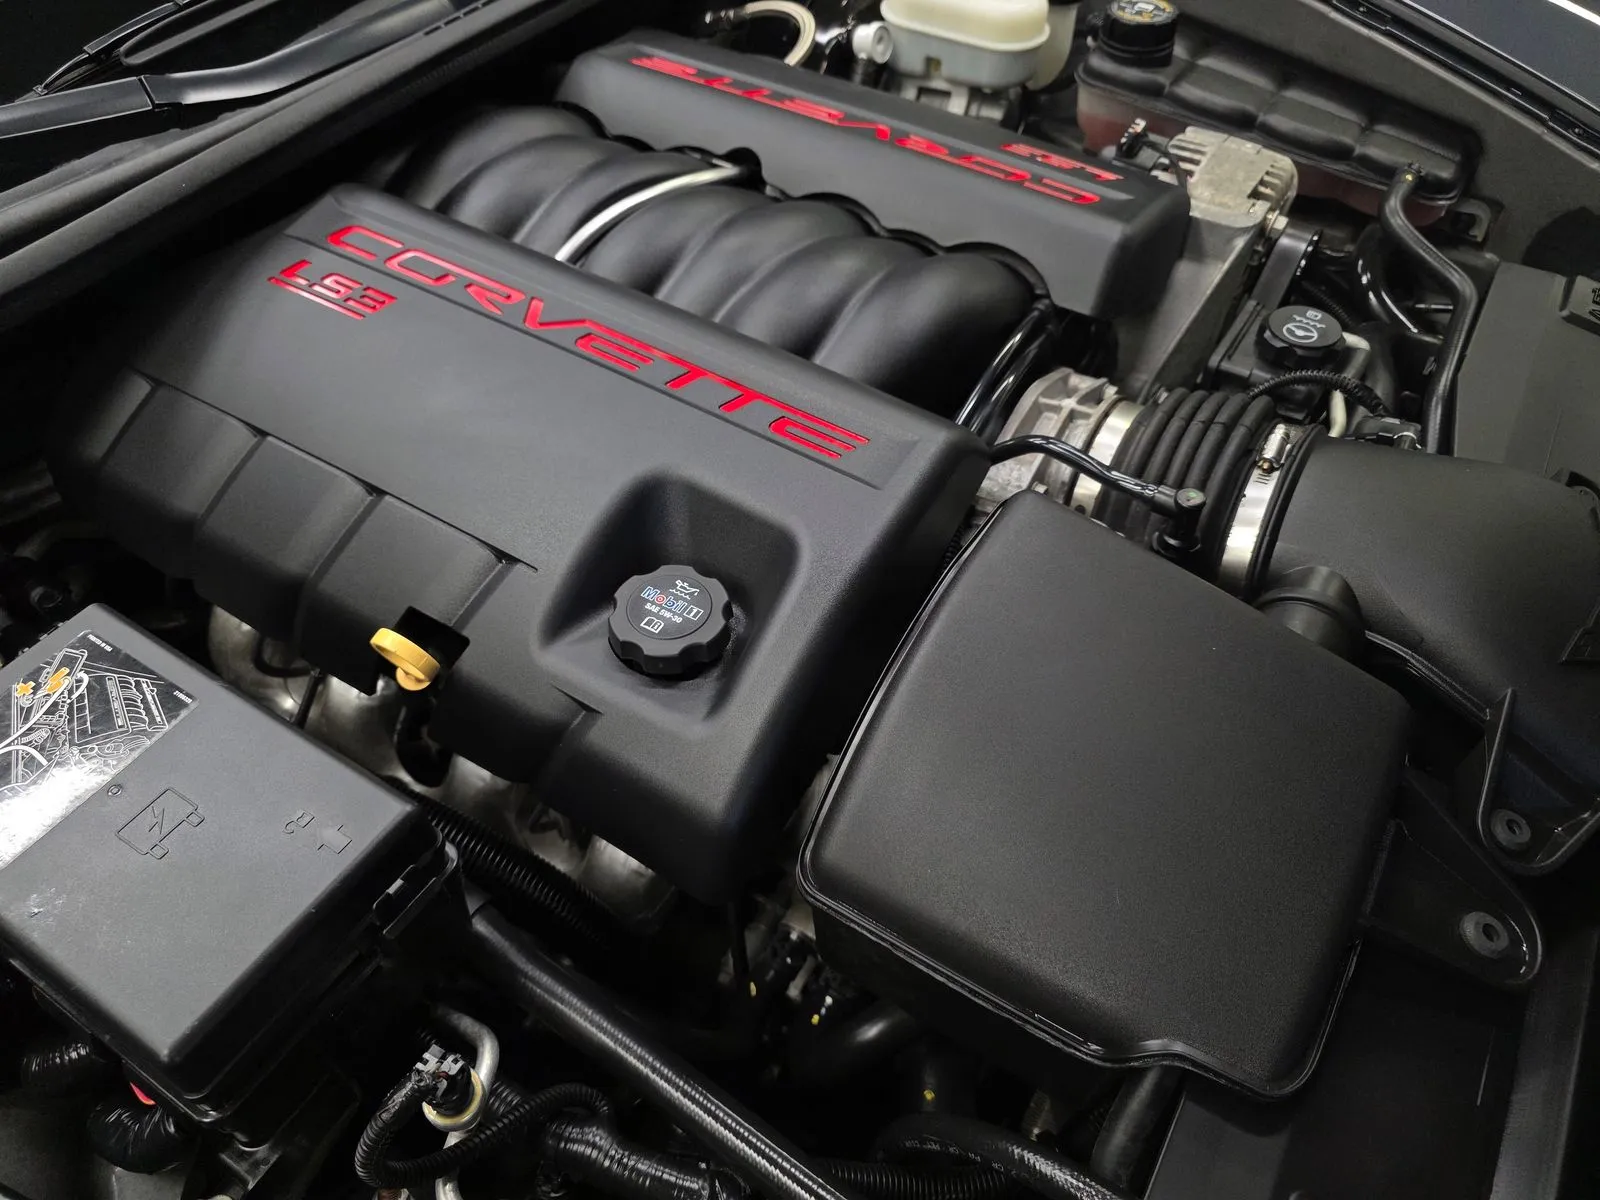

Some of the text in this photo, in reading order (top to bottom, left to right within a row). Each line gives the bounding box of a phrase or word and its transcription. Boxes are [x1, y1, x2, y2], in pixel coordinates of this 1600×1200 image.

[632, 58, 1100, 204] CORVETTE
[1001, 143, 1124, 181] LS3
[278, 260, 397, 314] LS3
[326, 224, 869, 460] CORVETTE
[640, 586, 687, 613] Mobil
[645, 602, 683, 624] SAE 5W-30
